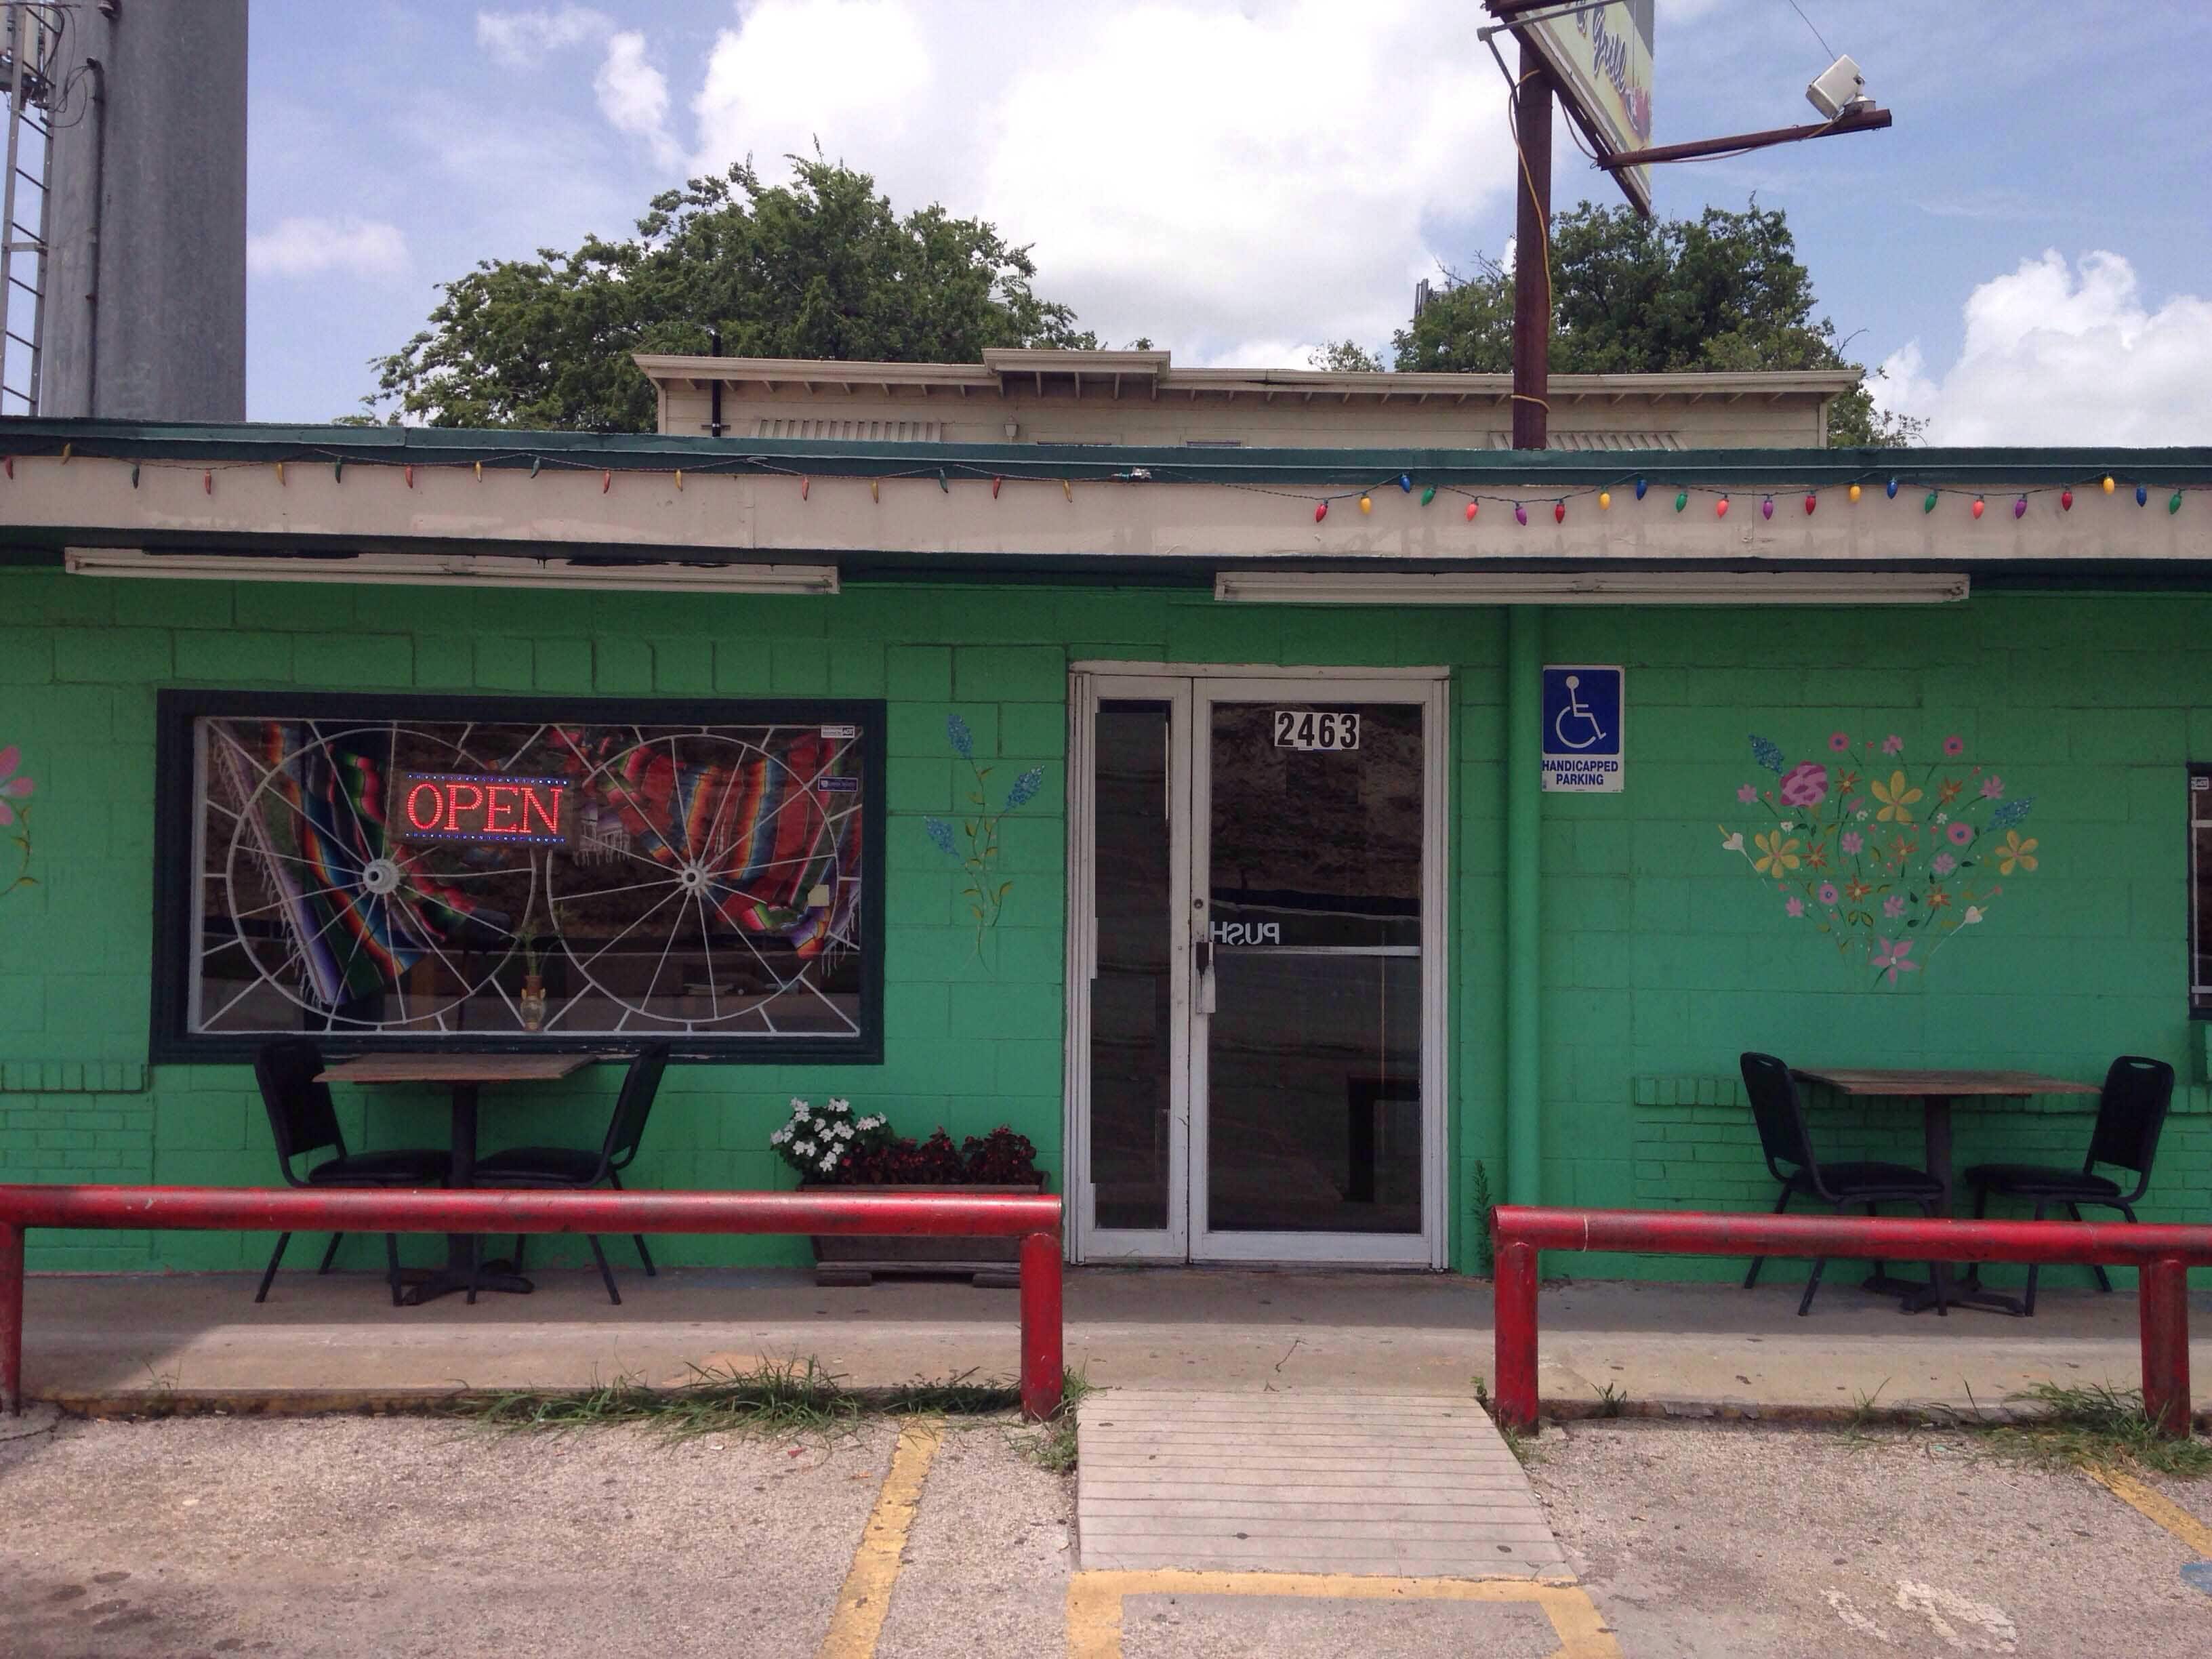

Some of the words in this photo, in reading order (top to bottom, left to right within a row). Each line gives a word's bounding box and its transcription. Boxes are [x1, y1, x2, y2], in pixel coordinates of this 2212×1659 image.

[1277, 712, 1357, 748] 2463
[1542, 760, 1618, 772] HANDICAPPED
[1555, 773, 1604, 785] PARKING
[407, 782, 563, 835] OPEN
